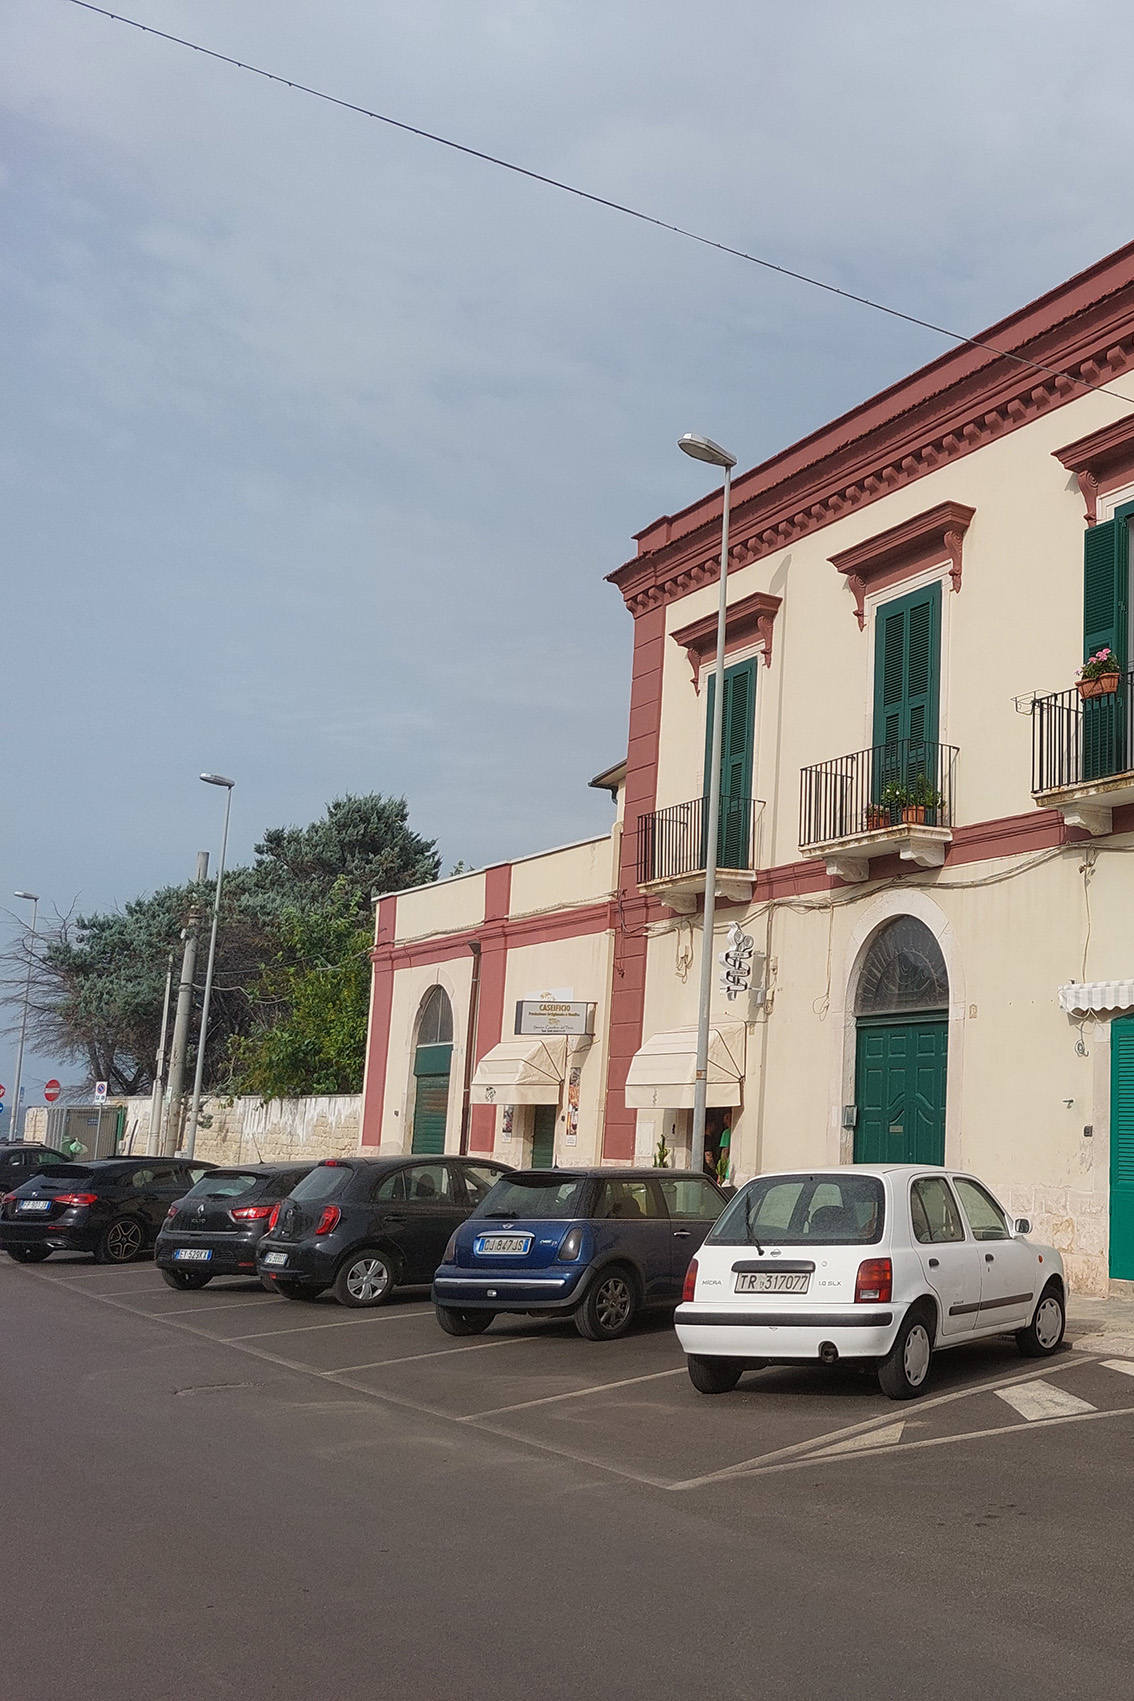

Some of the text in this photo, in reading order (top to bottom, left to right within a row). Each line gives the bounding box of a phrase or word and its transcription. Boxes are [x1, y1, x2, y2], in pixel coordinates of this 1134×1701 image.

[539, 1004, 570, 1012] CASEIFICIO
[740, 1274, 758, 1290] TR
[764, 1275, 808, 1291] 317077
